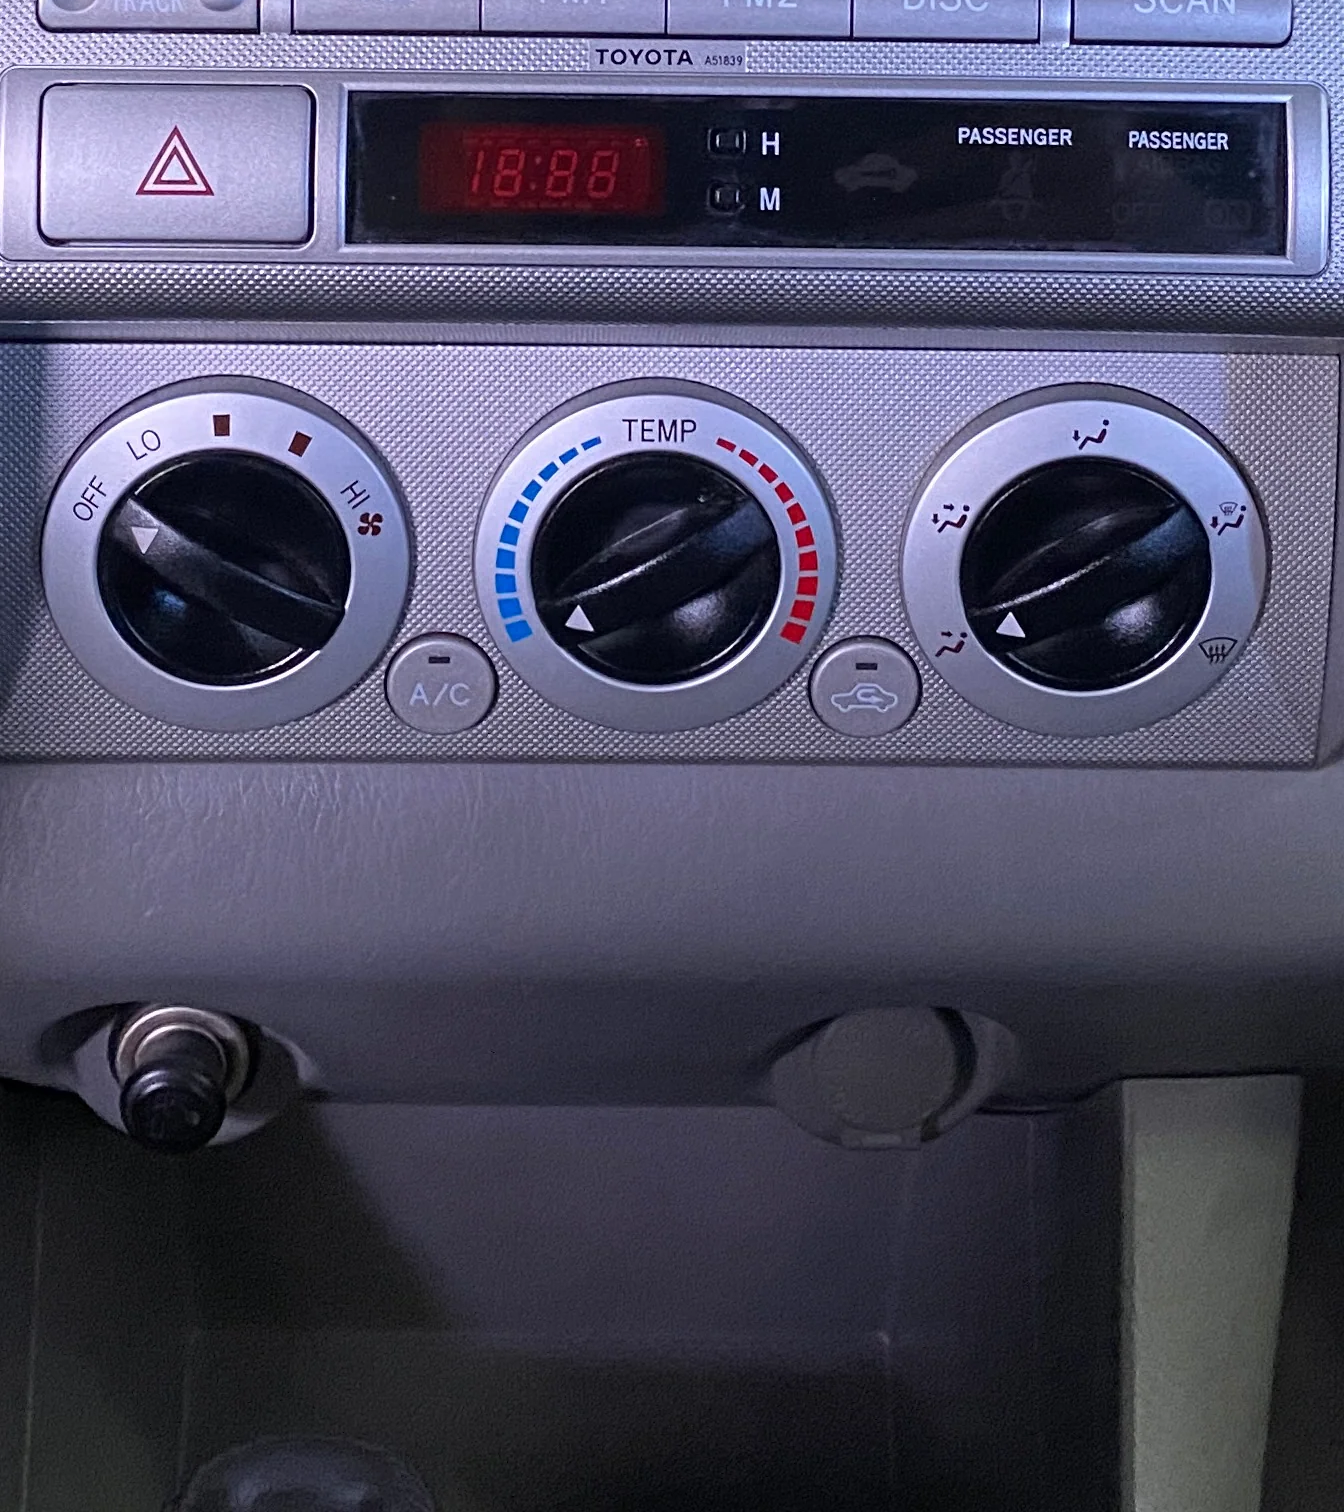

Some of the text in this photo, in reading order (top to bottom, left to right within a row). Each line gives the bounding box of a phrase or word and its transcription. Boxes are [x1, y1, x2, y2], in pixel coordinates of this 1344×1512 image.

[595, 48, 743, 66] TOYOTA A51839
[761, 132, 780, 156] H
[957, 126, 1073, 147] PASSENGER
[1128, 129, 1229, 151] PASSENGER
[759, 188, 780, 212] M
[622, 417, 698, 444] TEMP
[125, 428, 163, 461] LO
[72, 474, 109, 522] OFF
[340, 479, 371, 510] HI
[410, 681, 470, 705] A/C
